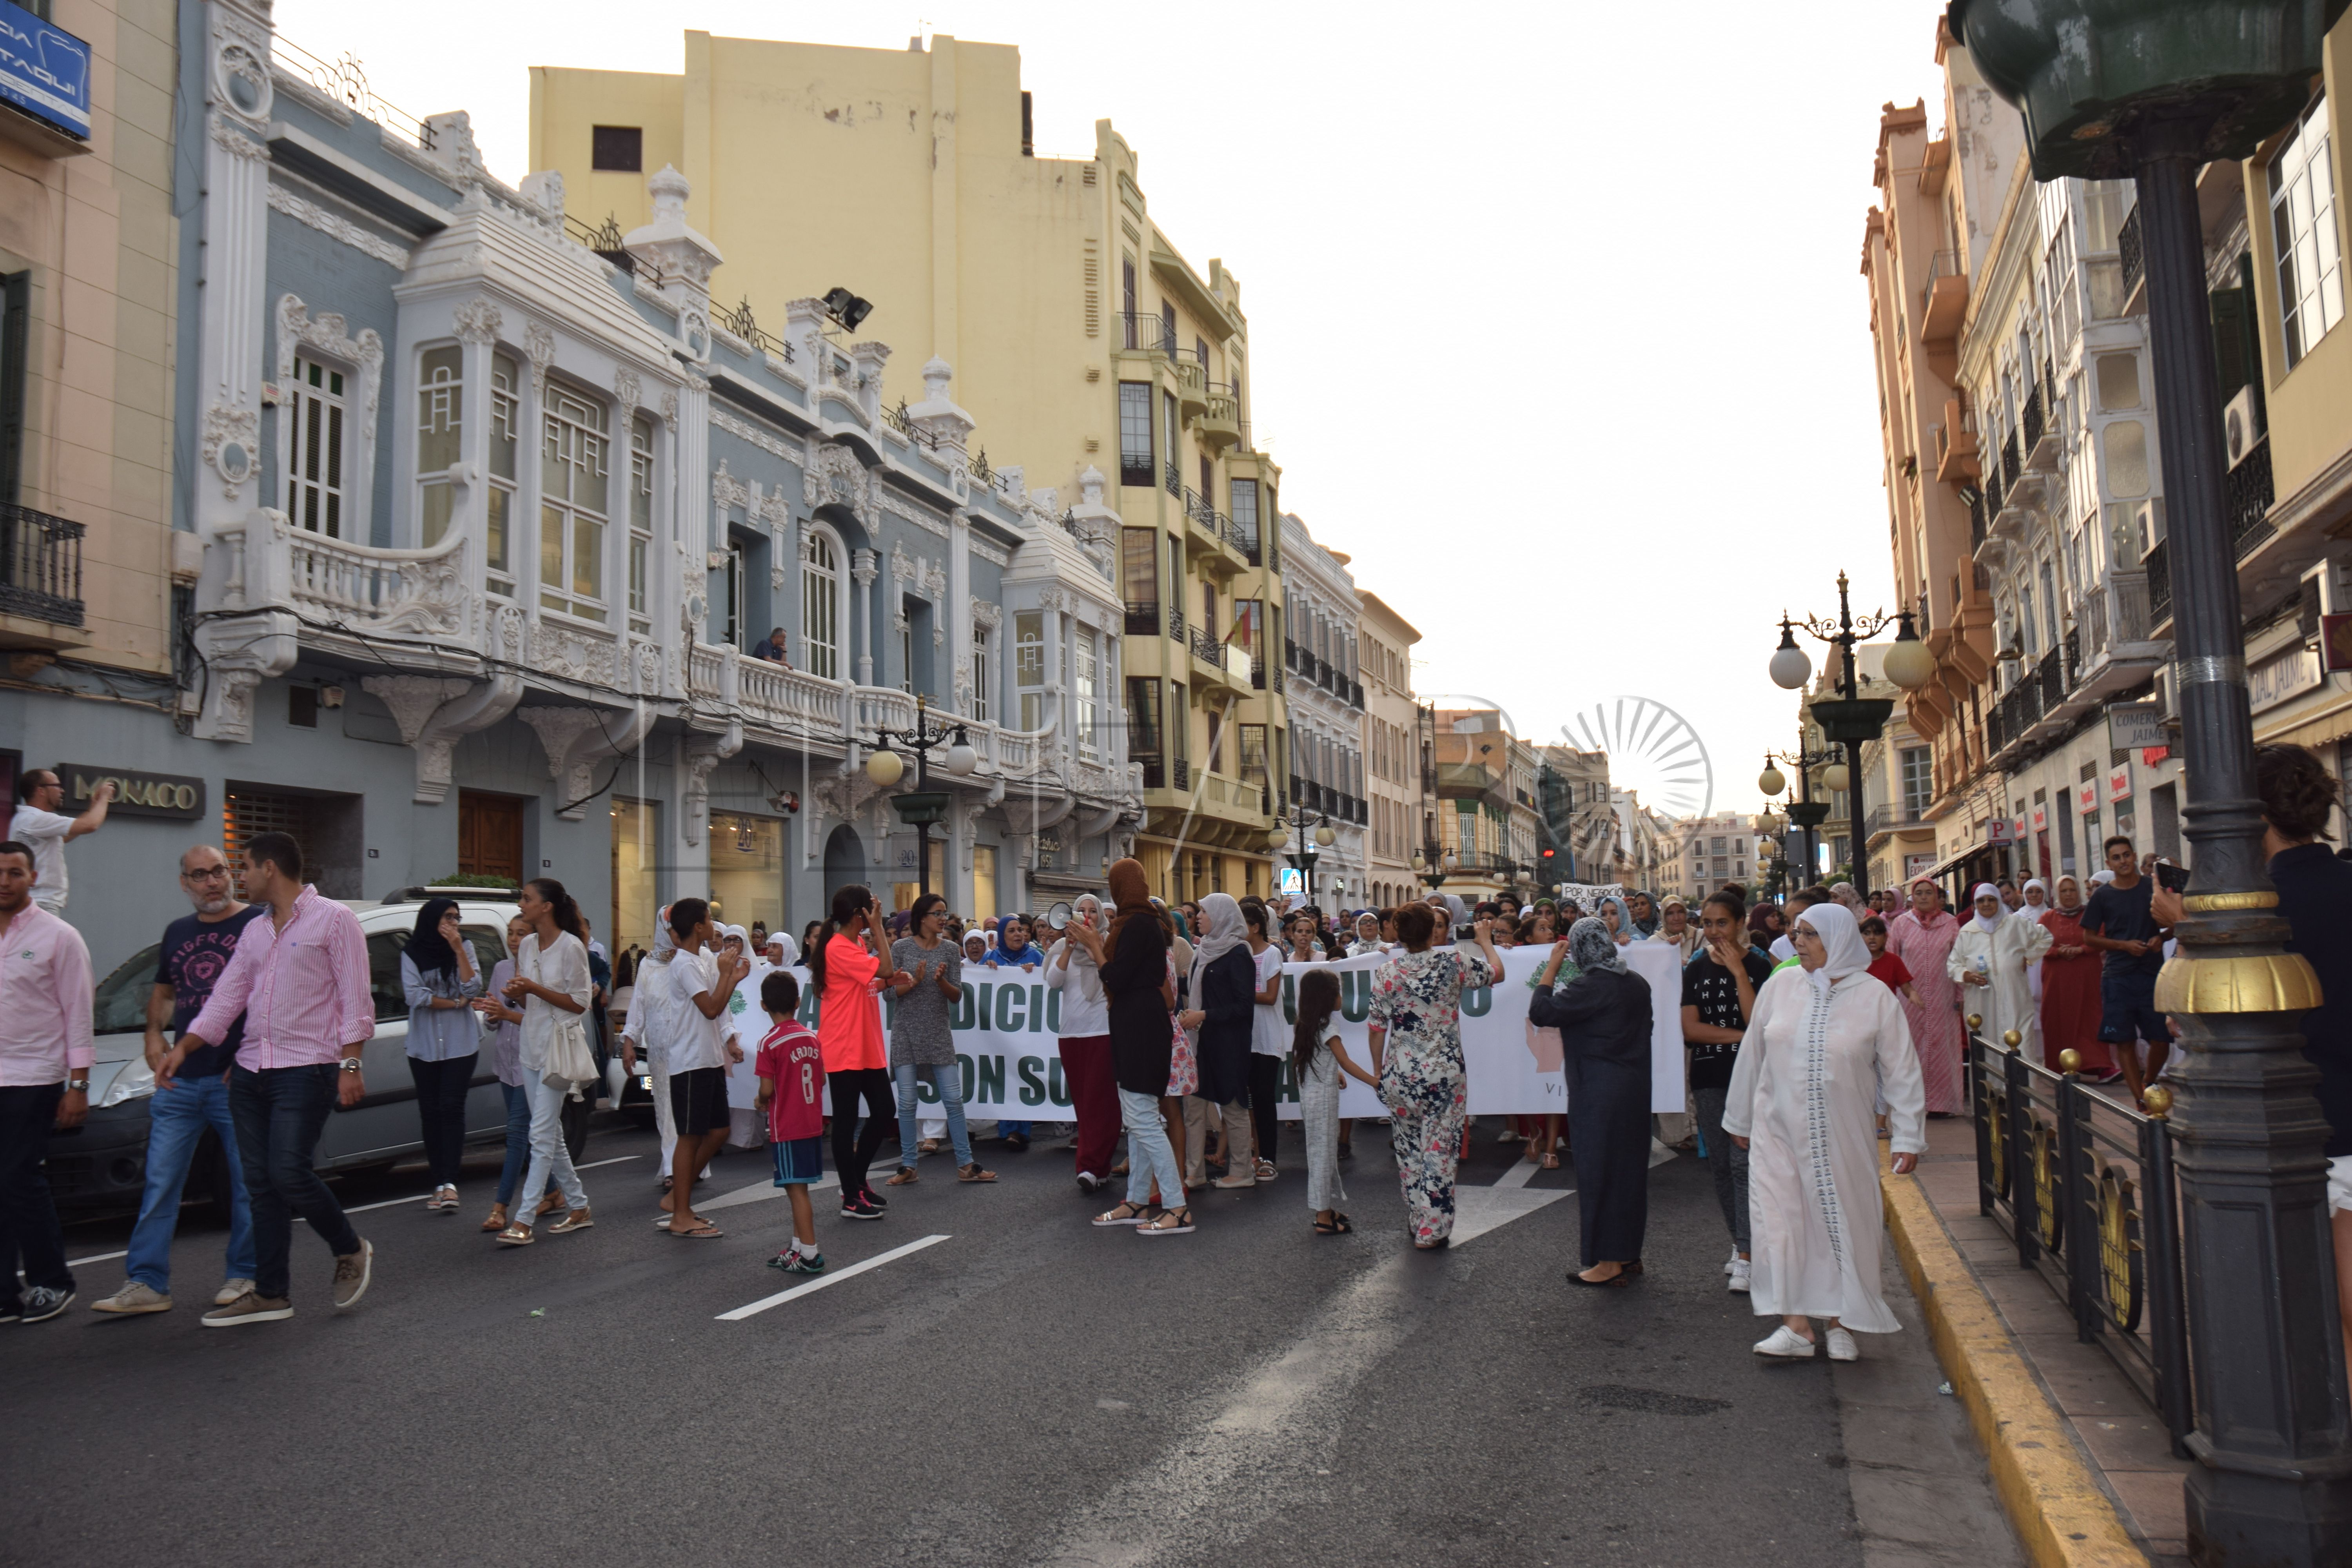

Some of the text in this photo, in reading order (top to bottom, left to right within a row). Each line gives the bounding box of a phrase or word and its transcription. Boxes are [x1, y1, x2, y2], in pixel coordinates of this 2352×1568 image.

[2130, 728, 2164, 744] JAIME
[74, 774, 197, 809] MONACO
[1991, 822, 2004, 838] P
[1565, 886, 1583, 897] POR
[789, 1046, 819, 1063] KROOS
[801, 1063, 814, 1104] 8
